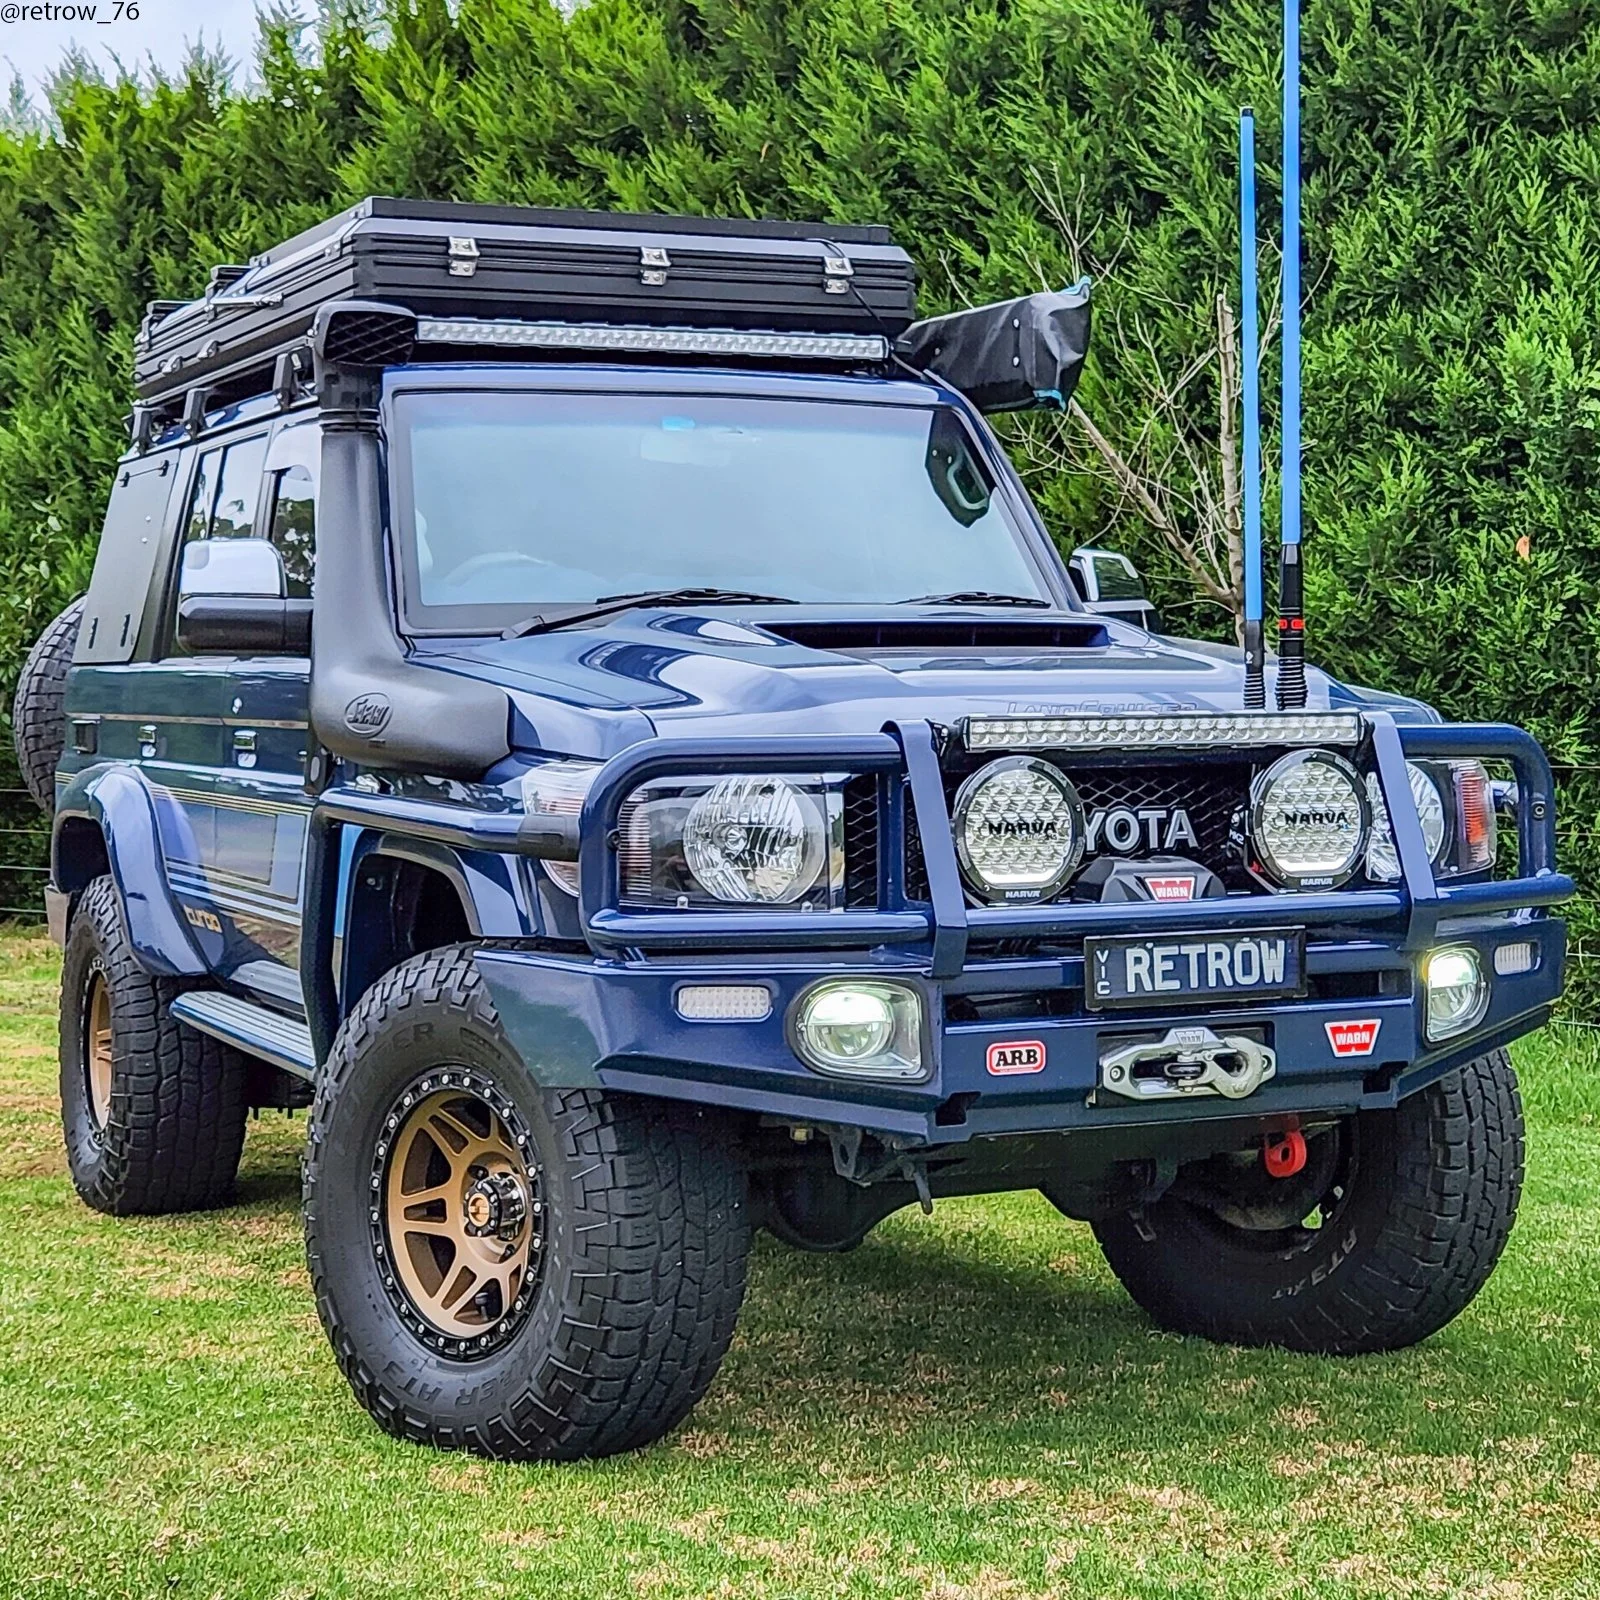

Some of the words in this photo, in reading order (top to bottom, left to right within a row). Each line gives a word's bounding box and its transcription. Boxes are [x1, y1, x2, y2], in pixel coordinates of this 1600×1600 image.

[1284, 811, 1348, 825] NARVA
[988, 821, 1057, 835] NARVA
[1300, 877, 1334, 886] NARVA
[1005, 889, 1041, 899] NARVA
[1155, 884, 1189, 899] WARN
[1096, 950, 1111, 995] VIC
[1125, 940, 1286, 993] RETROW
[1335, 1030, 1372, 1046] WARN
[995, 1048, 1038, 1067] ARB
